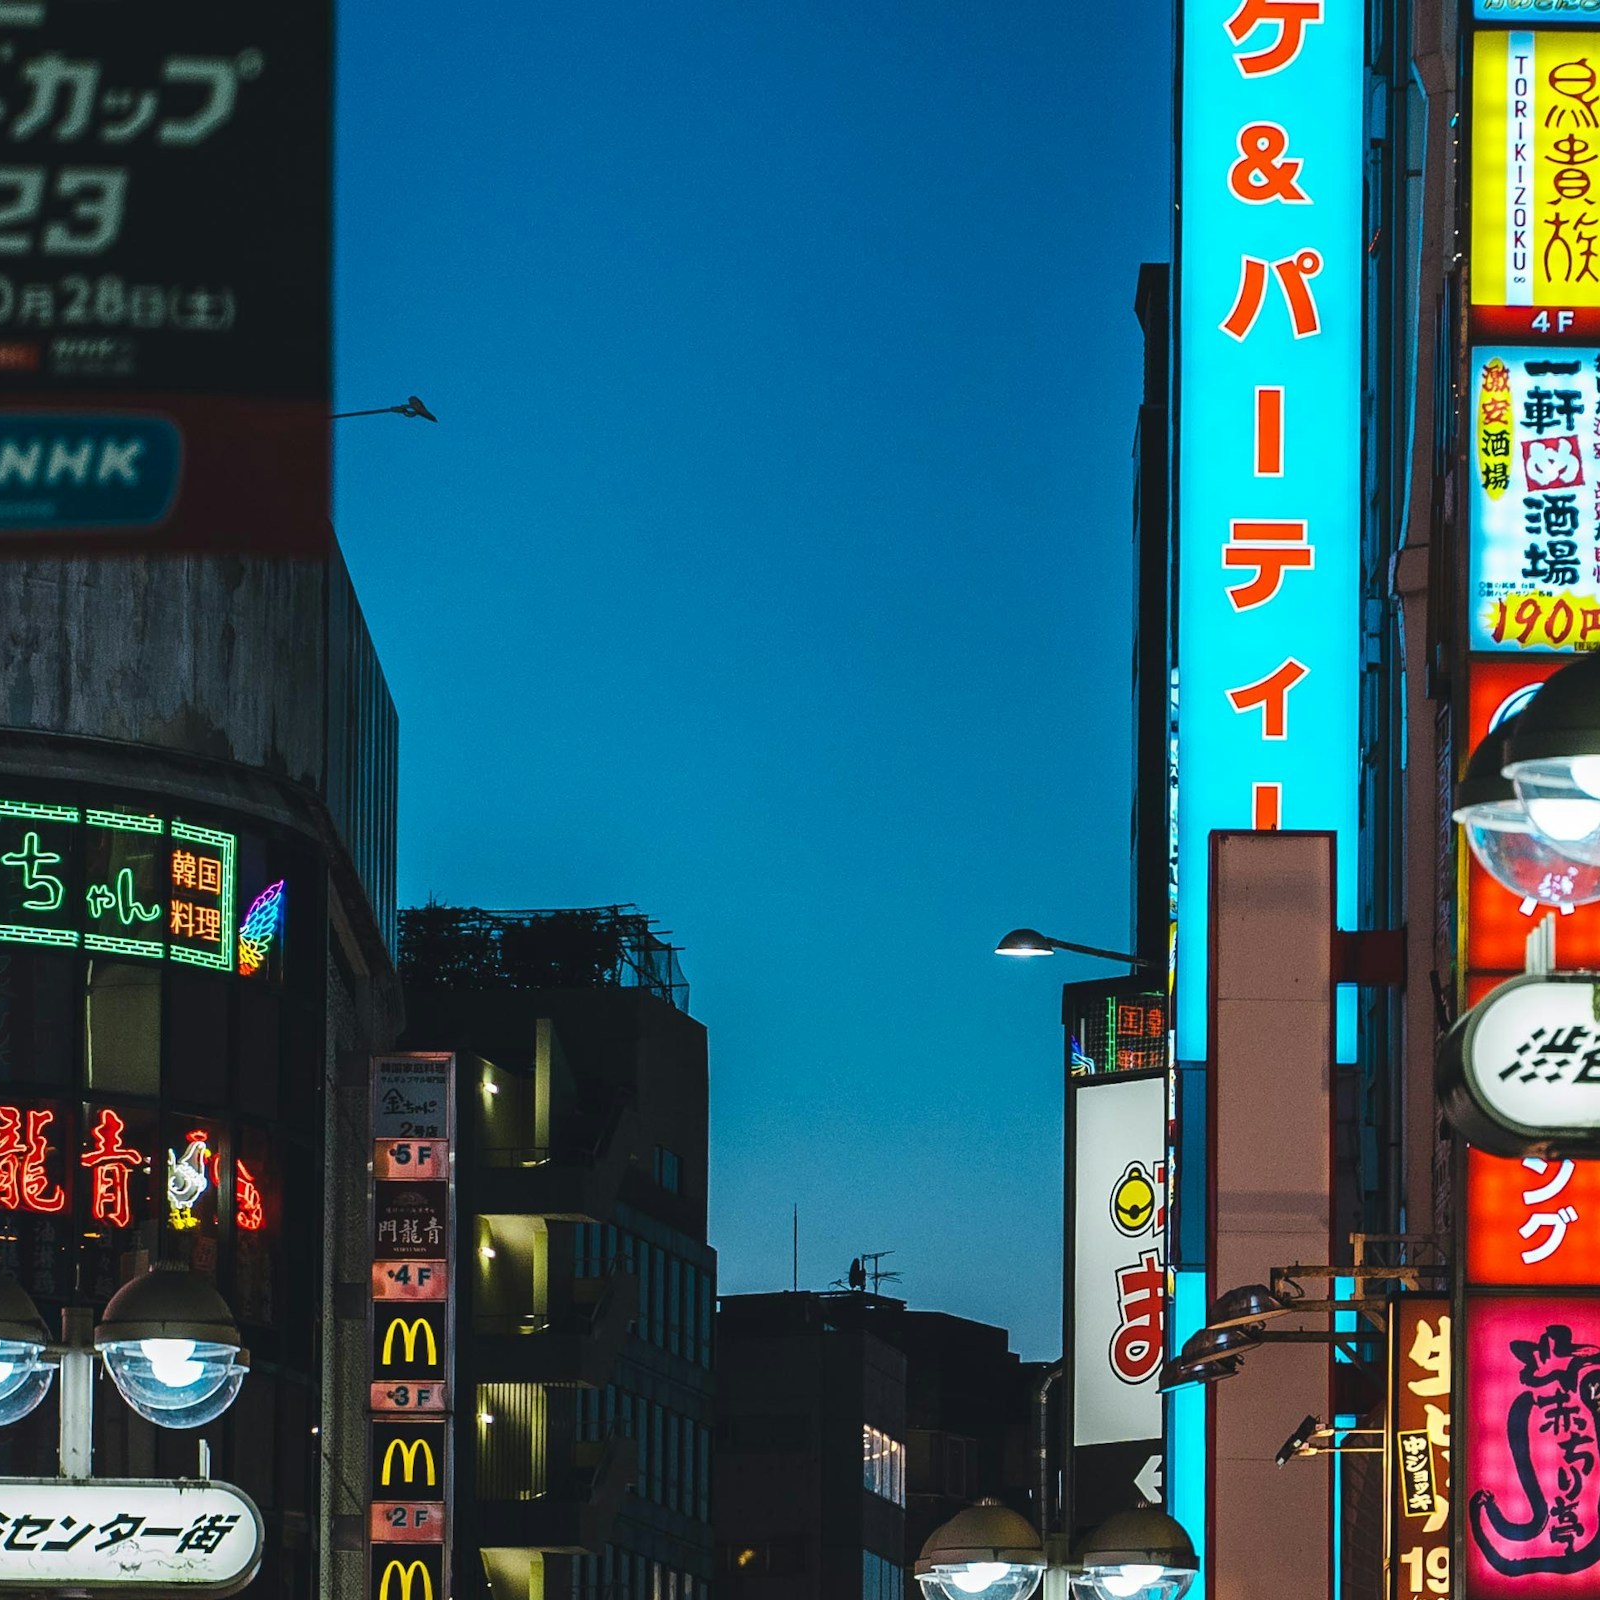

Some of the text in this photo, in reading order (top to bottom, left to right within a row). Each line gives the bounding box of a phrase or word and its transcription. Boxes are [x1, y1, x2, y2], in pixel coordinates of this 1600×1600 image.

[1513, 55, 1529, 271] TORIKIZOKU
[1520, 359, 1586, 587] 一軒め酒場
[170, 899, 222, 942] 料理
